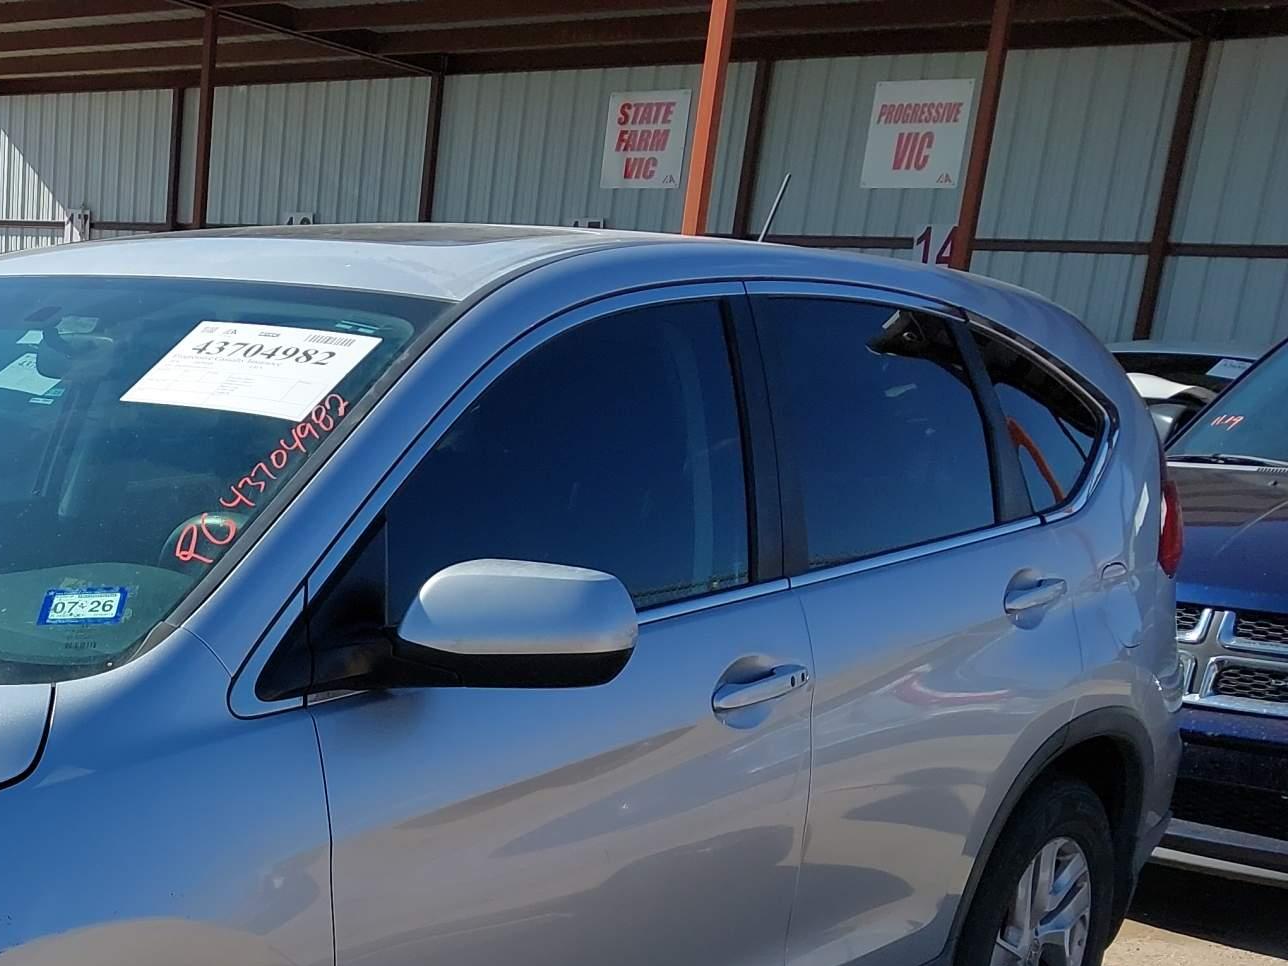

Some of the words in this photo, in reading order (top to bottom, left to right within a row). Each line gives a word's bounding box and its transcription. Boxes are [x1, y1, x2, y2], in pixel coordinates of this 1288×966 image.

[617, 102, 676, 126] STATE
[877, 102, 963, 125] PROGRESSIVE
[615, 129, 670, 152] FARM
[892, 131, 935, 170] VIC
[623, 157, 657, 180] VIC
[192, 339, 337, 366] 43704982
[219, 393, 349, 507] 43704982
[88, 600, 114, 612] 26
